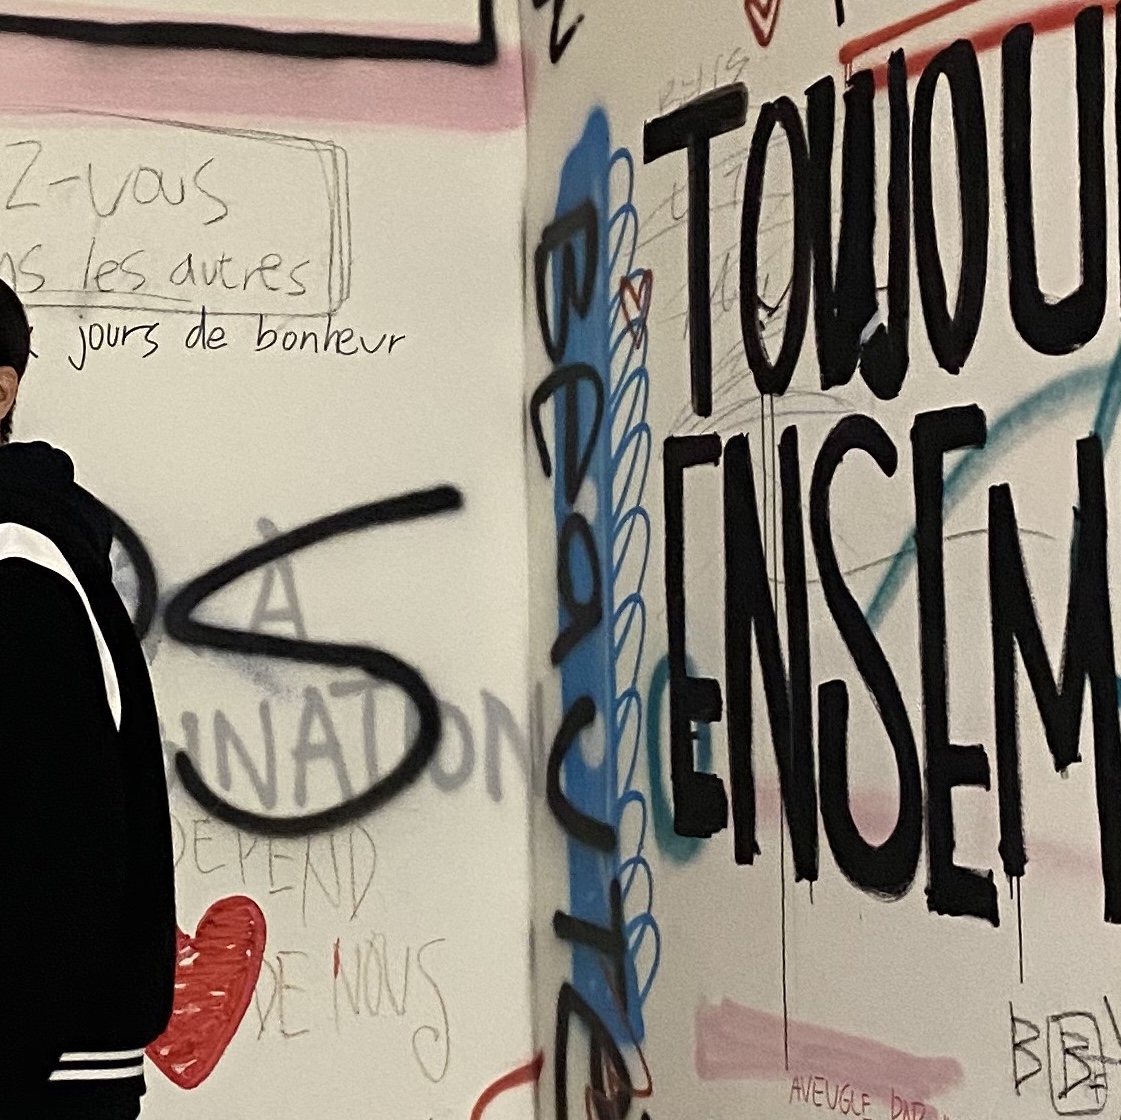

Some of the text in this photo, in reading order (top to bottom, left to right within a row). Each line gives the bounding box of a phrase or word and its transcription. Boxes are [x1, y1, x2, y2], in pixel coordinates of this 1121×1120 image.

[643, 4, 1121, 416] TOUJOU
[81, 236, 147, 293] les
[168, 249, 312, 298] autres
[67, 317, 161, 371] jours
[184, 304, 229, 351] de
[253, 314, 407, 356] bonheur
[332, 934, 452, 1084] NOUS
